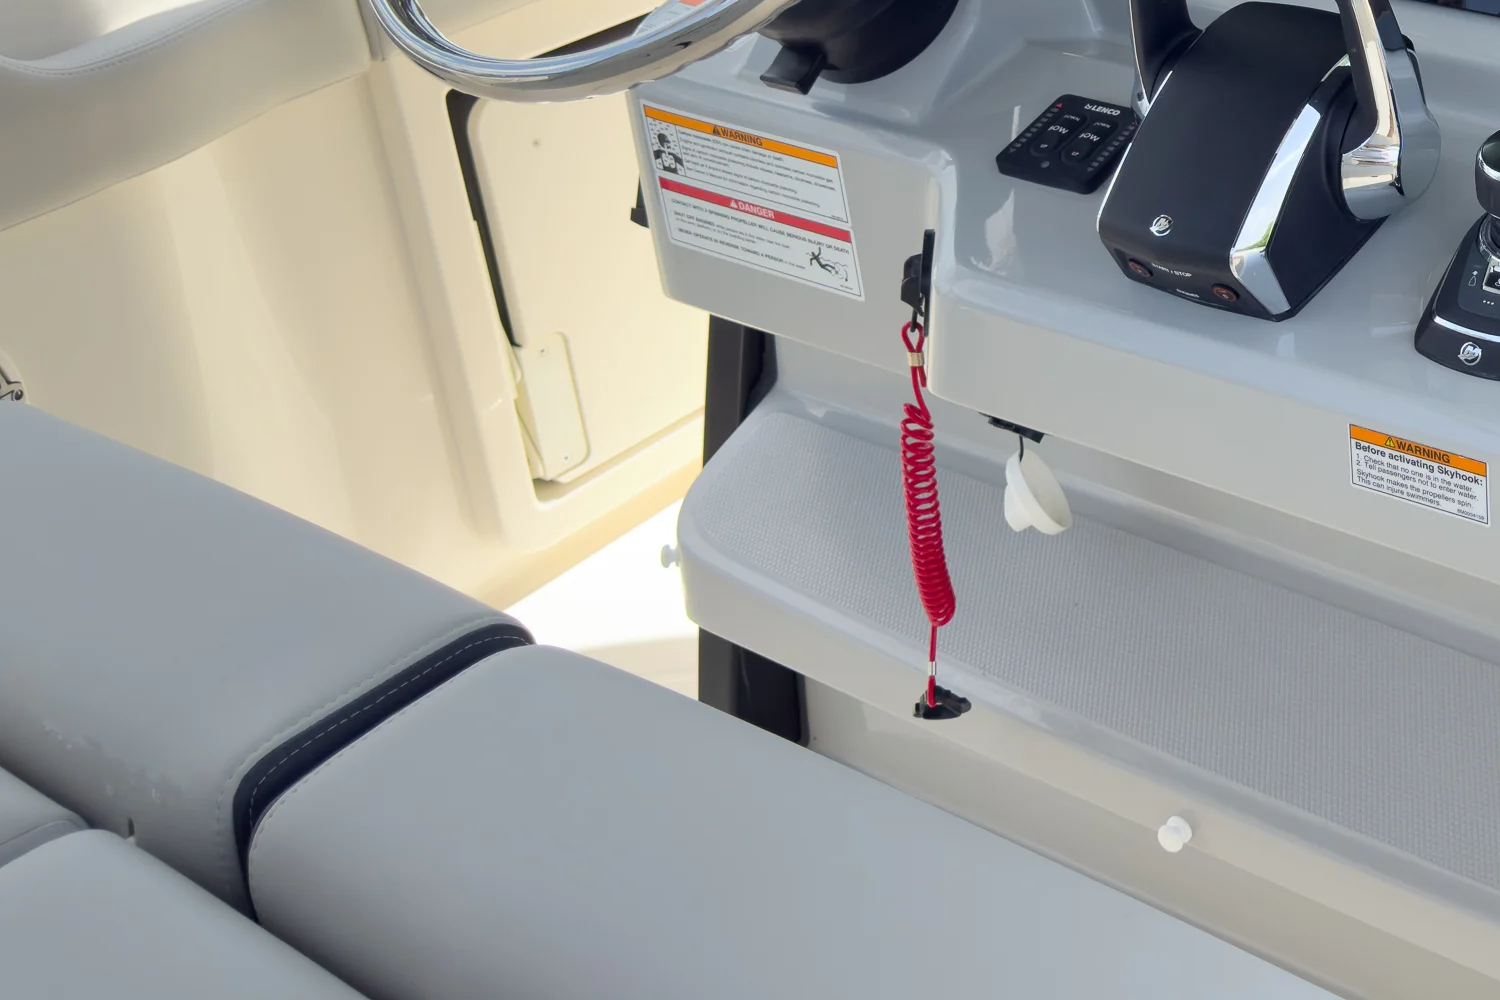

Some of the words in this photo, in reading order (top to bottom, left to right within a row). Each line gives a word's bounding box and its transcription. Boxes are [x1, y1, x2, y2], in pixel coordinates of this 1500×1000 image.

[1091, 104, 1121, 116] LENCO
[720, 127, 762, 145] WARNING
[737, 201, 774, 218] DANGER
[1355, 441, 1385, 457] Before
[1388, 450, 1434, 473] activating
[1437, 465, 1482, 487] Skyhook:
[1396, 440, 1450, 463] WARNING
[1356, 468, 1384, 482] Skyhook
[1386, 477, 1408, 489] makes
[1410, 484, 1420, 492] the
[1422, 488, 1455, 504] propellers
[1457, 499, 1473, 509] spin.
[1363, 455, 1384, 466] Check
[1386, 462, 1398, 471] that
[1411, 470, 1423, 478] one
[1441, 478, 1450, 486] the
[1453, 482, 1473, 493] water.
[1364, 462, 1376, 470] Tell
[1378, 466, 1415, 483] passengers
[1418, 478, 1428, 486] not
[1439, 484, 1455, 494] enter
[1458, 490, 1478, 501] water.
[1357, 475, 1370, 485] This
[1372, 481, 1384, 489] can
[1386, 484, 1404, 496] injure
[1406, 491, 1441, 506] swimmers.
